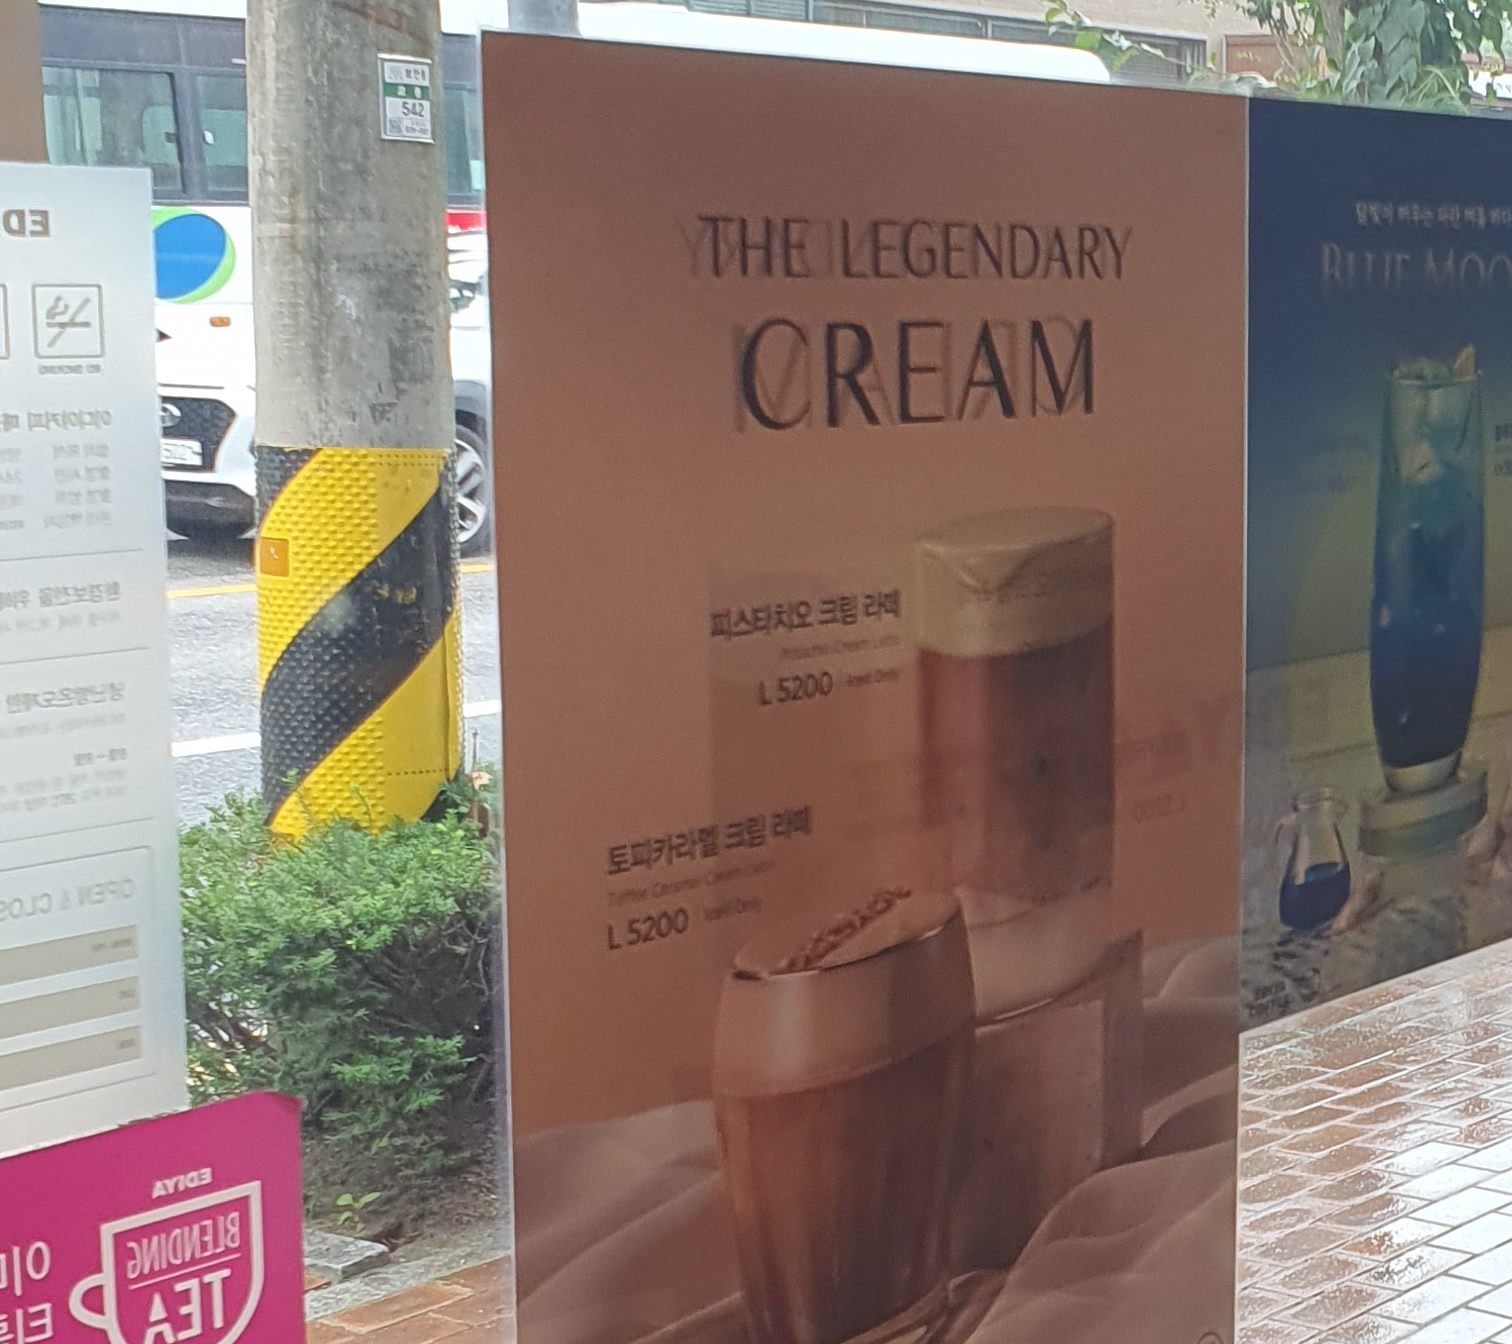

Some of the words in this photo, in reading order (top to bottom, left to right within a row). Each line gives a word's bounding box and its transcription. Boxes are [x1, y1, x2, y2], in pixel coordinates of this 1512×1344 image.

[401, 101, 425, 118] 542
[698, 213, 810, 279] THE
[841, 215, 1132, 281] LEGENDARY
[1319, 242, 1411, 290] BLUE
[740, 316, 1096, 430] CREAM
[710, 601, 813, 640] 피스타치오
[817, 594, 859, 626] 크림
[864, 588, 901, 622] 라떼
[759, 679, 773, 706] L
[776, 670, 834, 703] 5200
[606, 823, 720, 877] 토피카라멜
[723, 814, 767, 850] 크림
[606, 923, 622, 951] L
[625, 907, 689, 946] 5200
